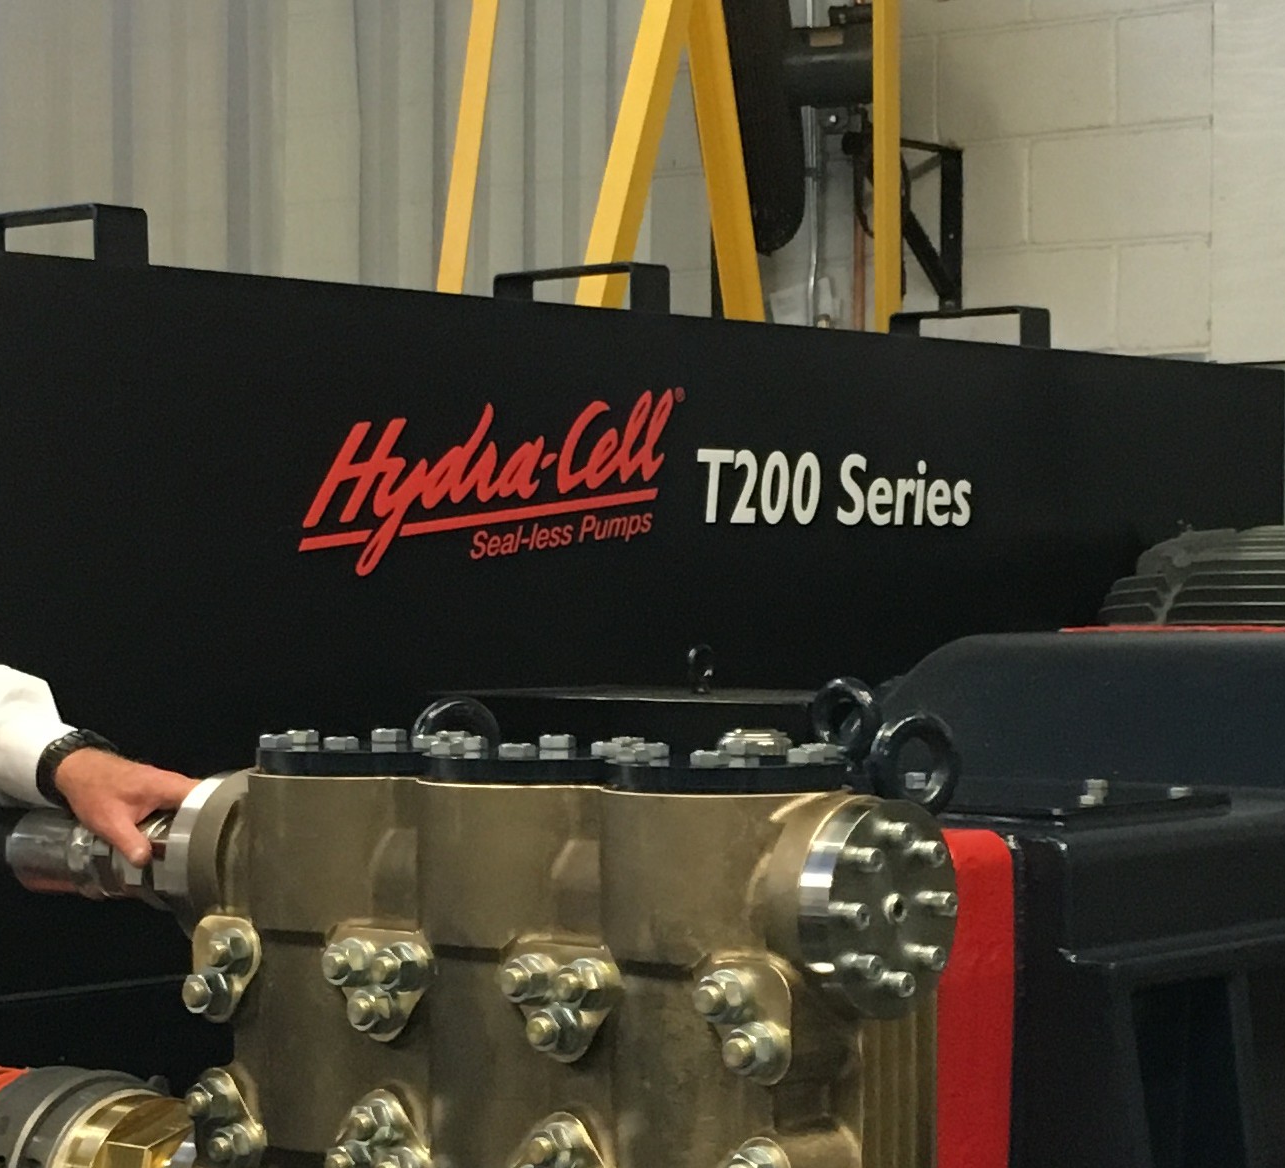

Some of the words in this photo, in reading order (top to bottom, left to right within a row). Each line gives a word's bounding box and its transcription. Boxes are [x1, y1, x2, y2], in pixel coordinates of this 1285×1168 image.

[697, 447, 820, 526] T200
[836, 454, 972, 528] Series
[469, 523, 572, 561] Seal-less
[578, 511, 653, 547] Pumps
